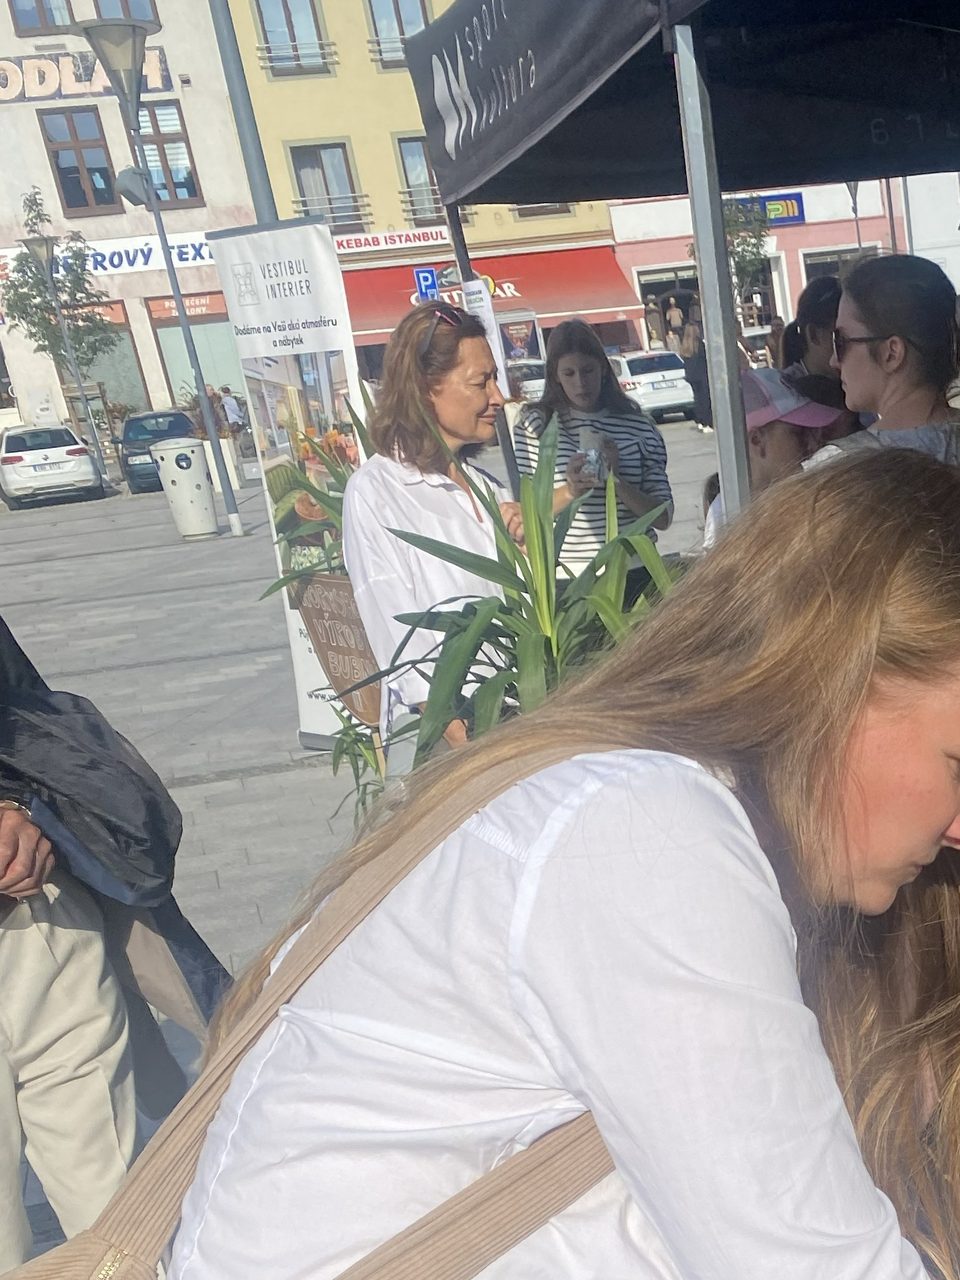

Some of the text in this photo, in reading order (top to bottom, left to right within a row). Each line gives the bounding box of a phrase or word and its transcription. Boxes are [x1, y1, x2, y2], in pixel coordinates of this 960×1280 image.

[336, 230, 447, 250] KEBAB ISTANBUL
[260, 259, 309, 279] VESTIBUL
[266, 279, 312, 300] INTERIER
